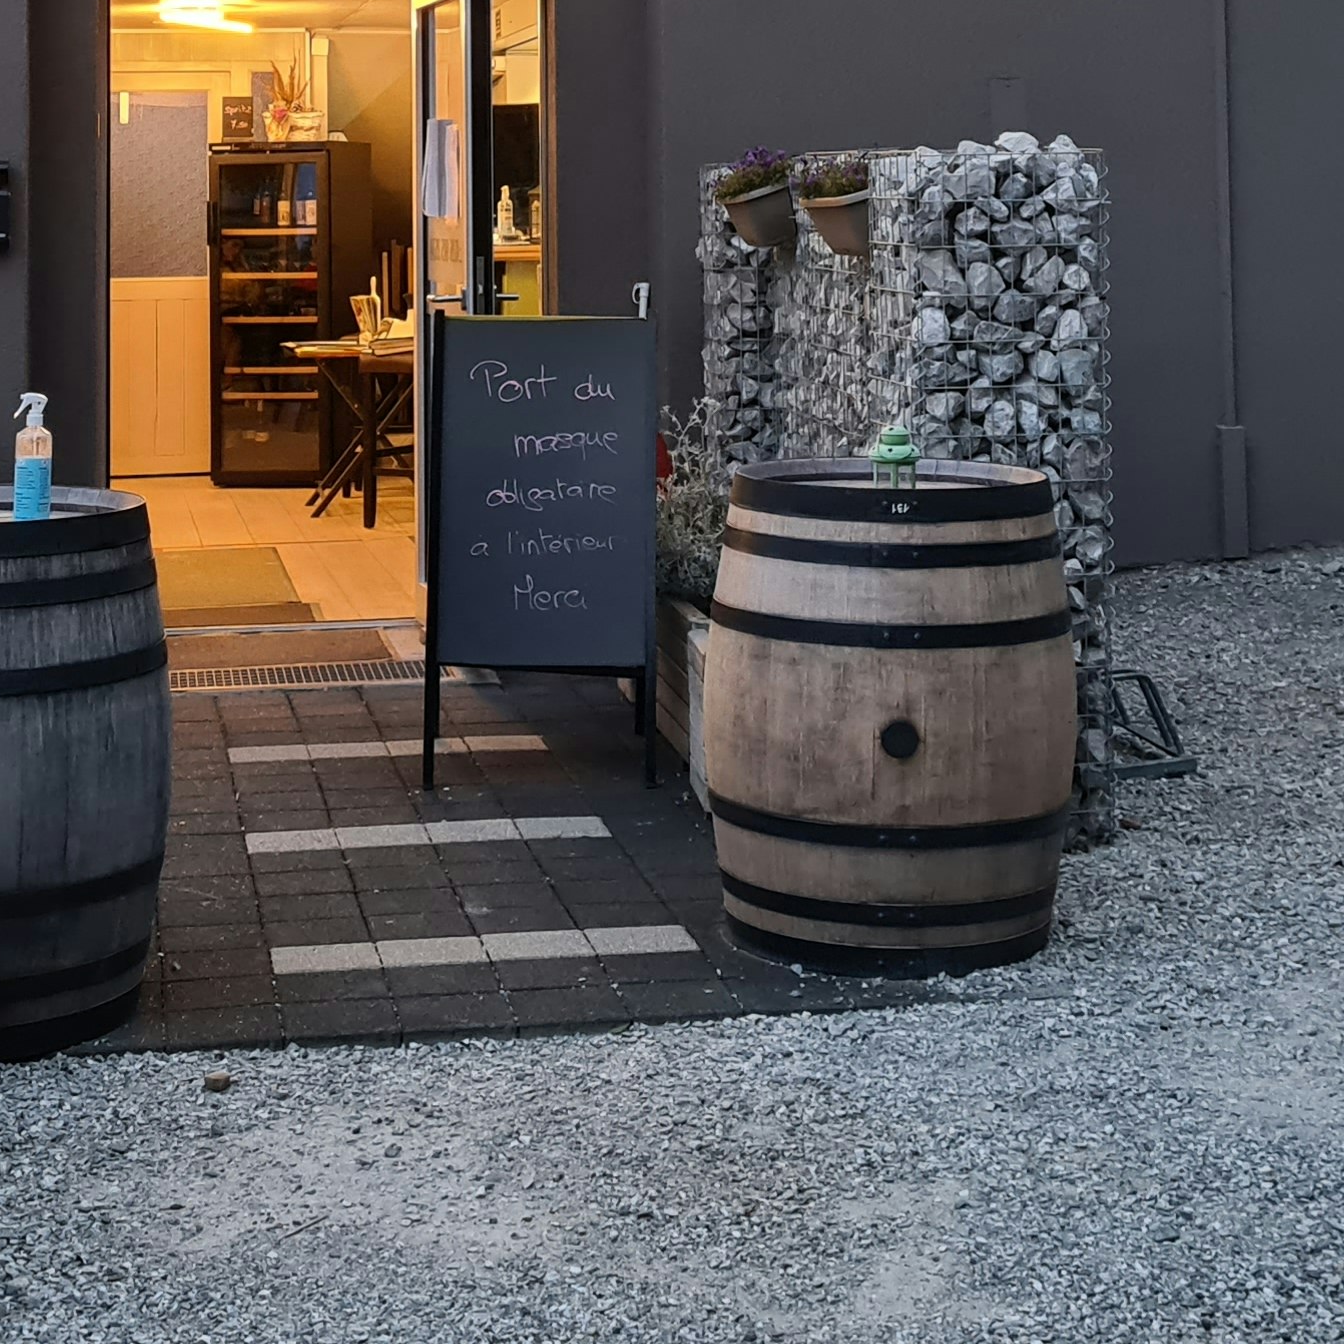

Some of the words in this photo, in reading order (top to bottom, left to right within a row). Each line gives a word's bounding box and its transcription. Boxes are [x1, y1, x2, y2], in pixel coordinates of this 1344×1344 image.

[470, 360, 557, 402] Port
[574, 374, 616, 401] du
[514, 432, 618, 460] masque
[514, 574, 588, 611] Merci
